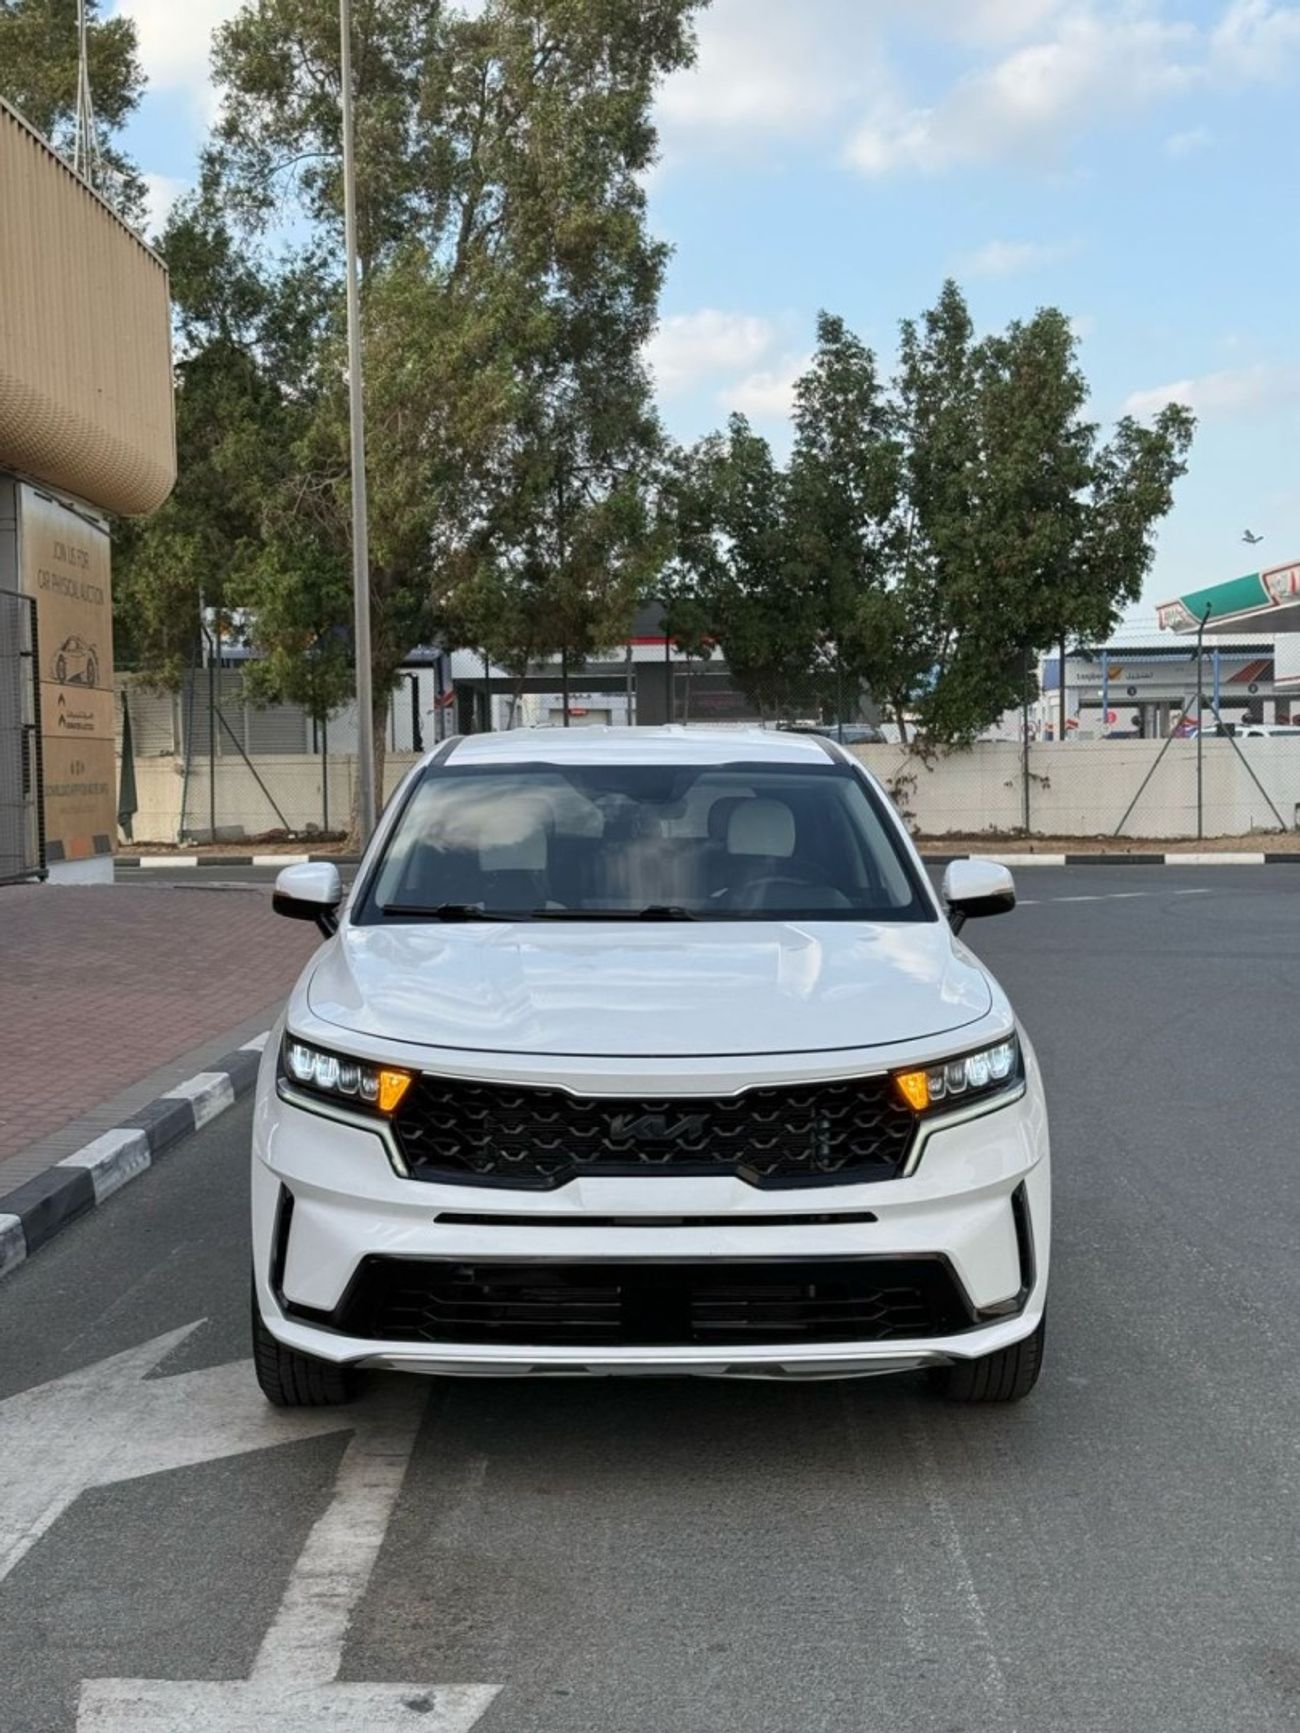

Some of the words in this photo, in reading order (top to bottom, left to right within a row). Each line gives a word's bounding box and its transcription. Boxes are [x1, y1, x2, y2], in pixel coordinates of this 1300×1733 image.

[53, 541, 67, 561] JOIN
[77, 549, 89, 570] FOR
[80, 583, 104, 605] AUCTION
[610, 1114, 706, 1140] KIA
